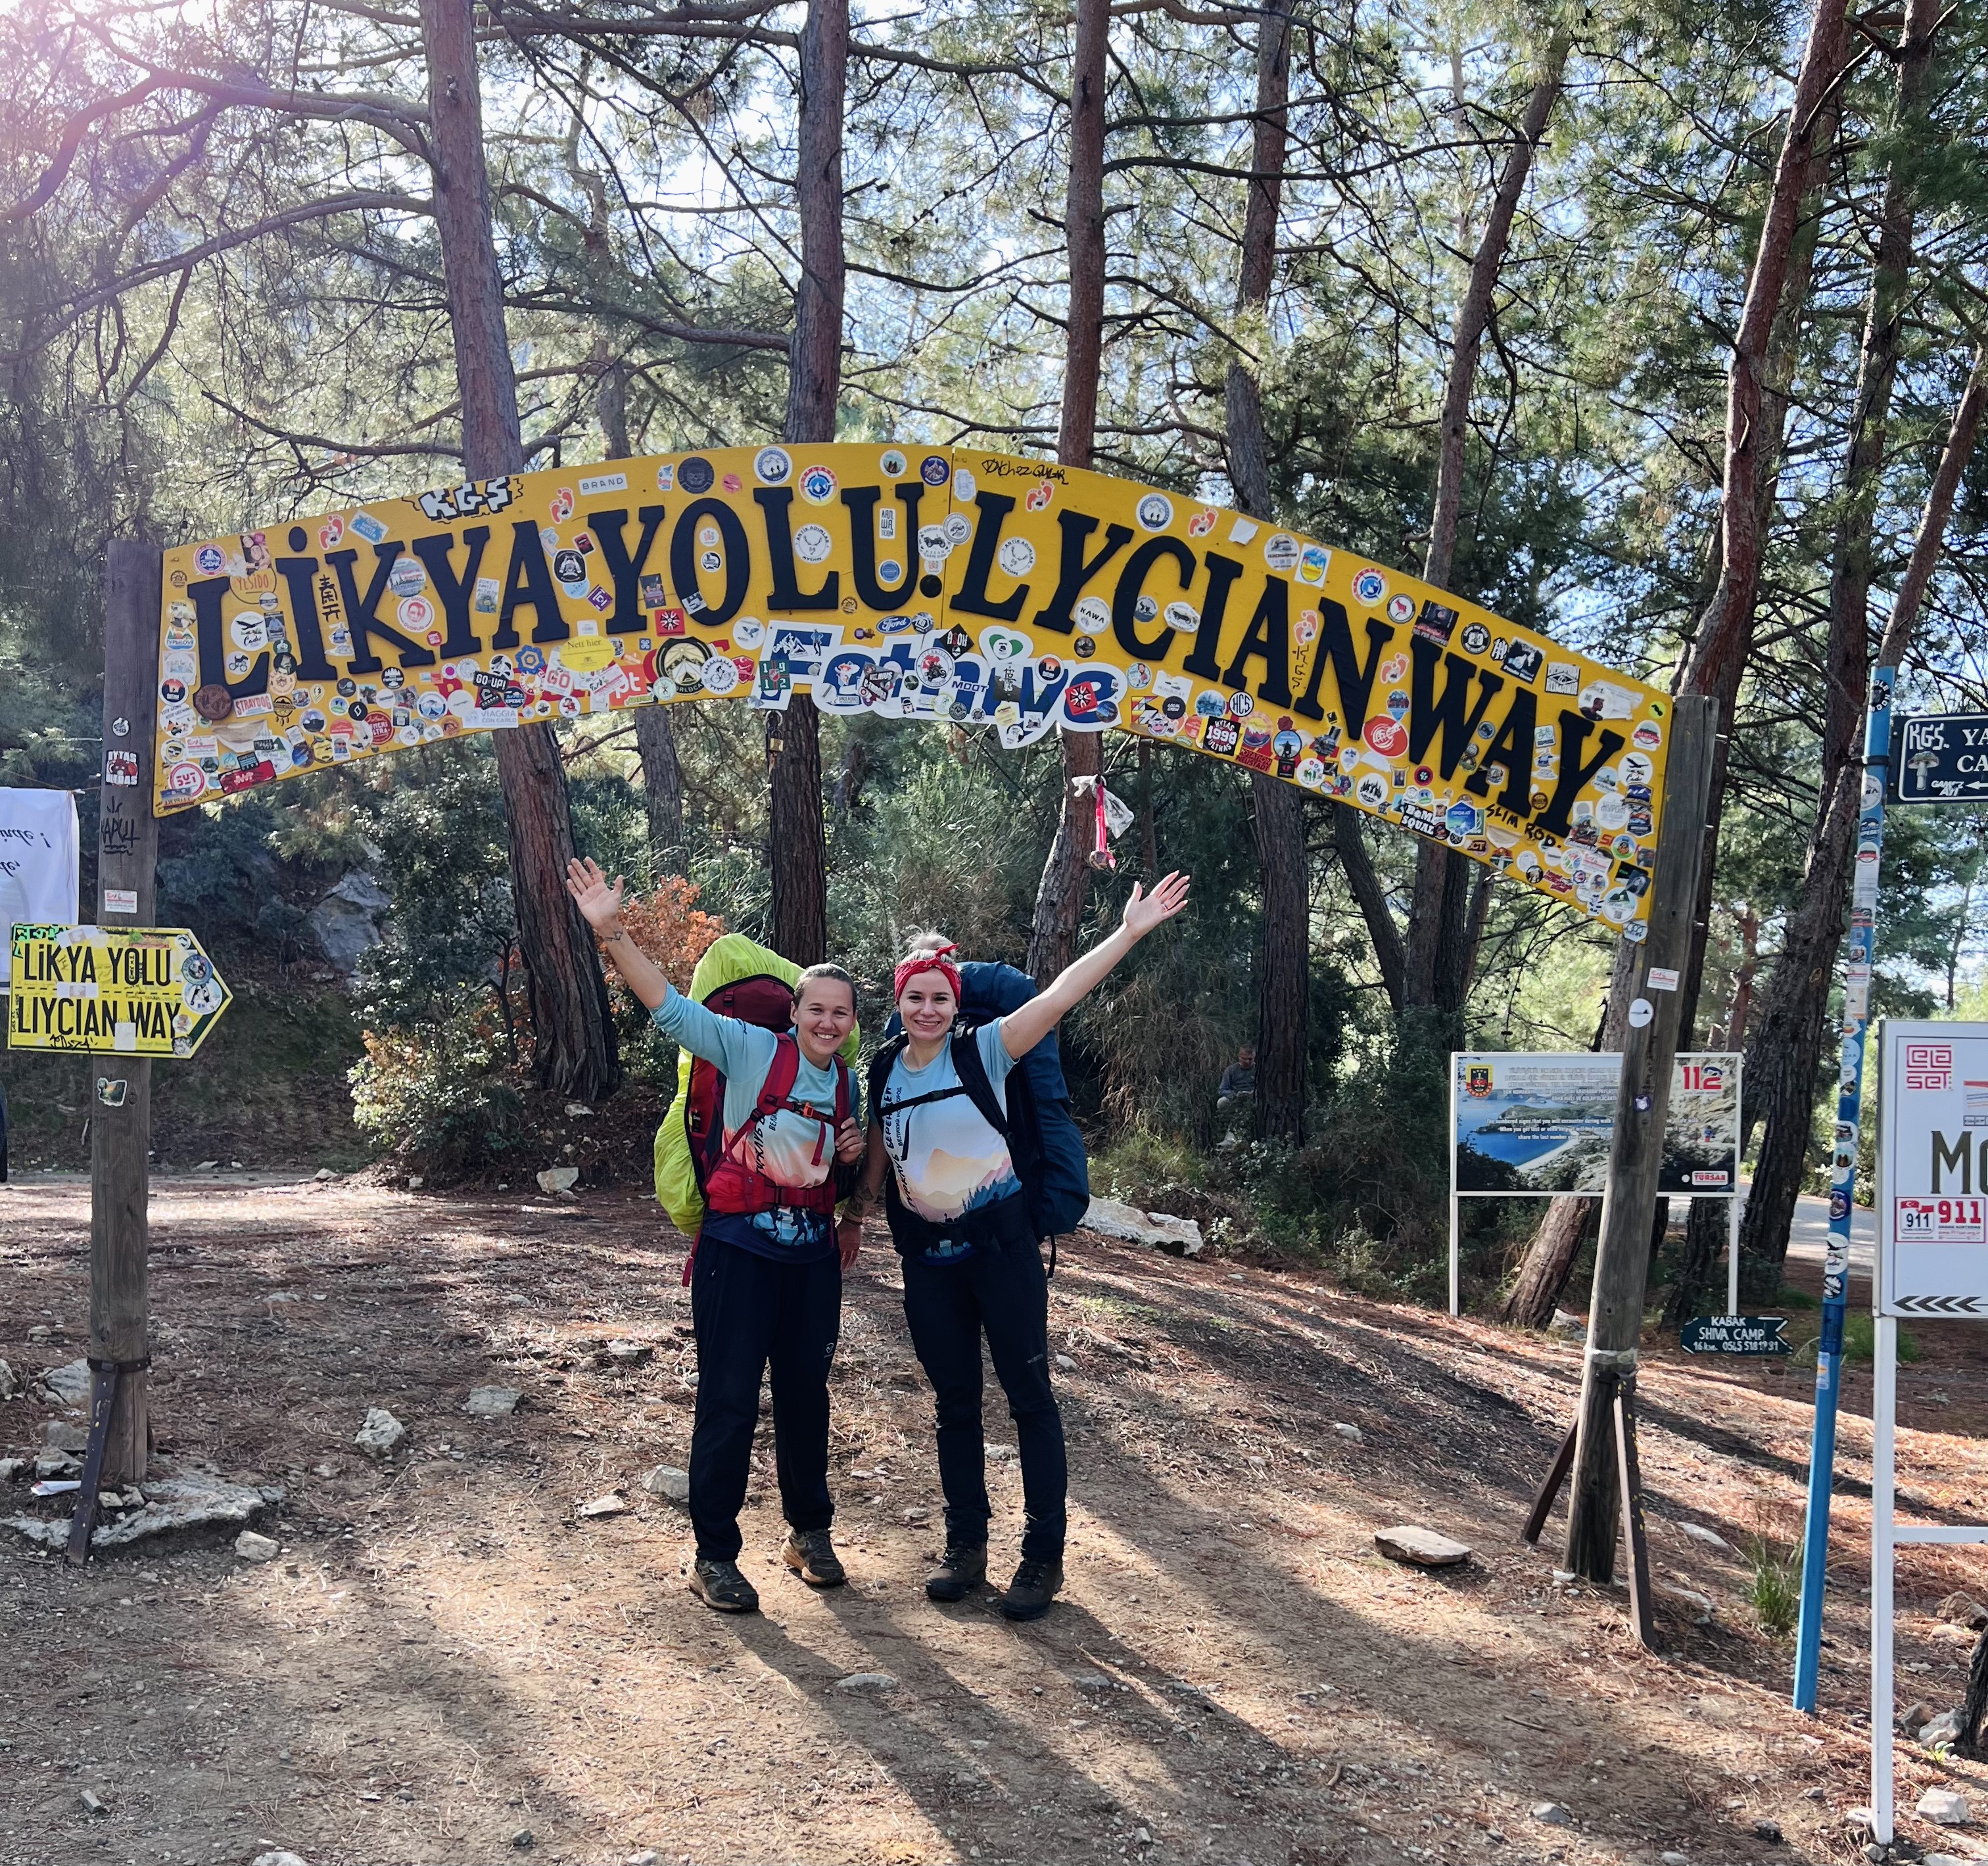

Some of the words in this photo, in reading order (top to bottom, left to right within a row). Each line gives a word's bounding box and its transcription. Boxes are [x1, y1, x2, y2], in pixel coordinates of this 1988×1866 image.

[582, 477, 624, 490] BRAND
[418, 477, 513, 521] KGS
[588, 482, 924, 635] YOLU
[883, 618, 907, 630] Ford
[1080, 606, 1105, 623] KAWA
[567, 640, 584, 649] Nett
[949, 490, 1395, 741] LYCIAN
[1410, 632, 1625, 838] WAY
[476, 674, 488, 685] GO
[491, 678, 506, 690] UP!
[952, 680, 987, 692] MOOT
[236, 695, 272, 715] STRAYDOG
[1206, 725, 1237, 745] 1998
[1486, 803, 1519, 828] SLIM
[107, 947, 170, 986] YOLU
[18, 996, 117, 1037] LIYCIAN
[128, 1000, 181, 1038] WAY
[1683, 1065, 1723, 1090] 112
[1906, 1213, 1929, 1227] 911
[1938, 1200, 1981, 1223] 911
[1711, 1317, 1746, 1326] KABAK
[1699, 1327, 1730, 1341] SHIVA
[1733, 1328, 1765, 1341] CAMP
